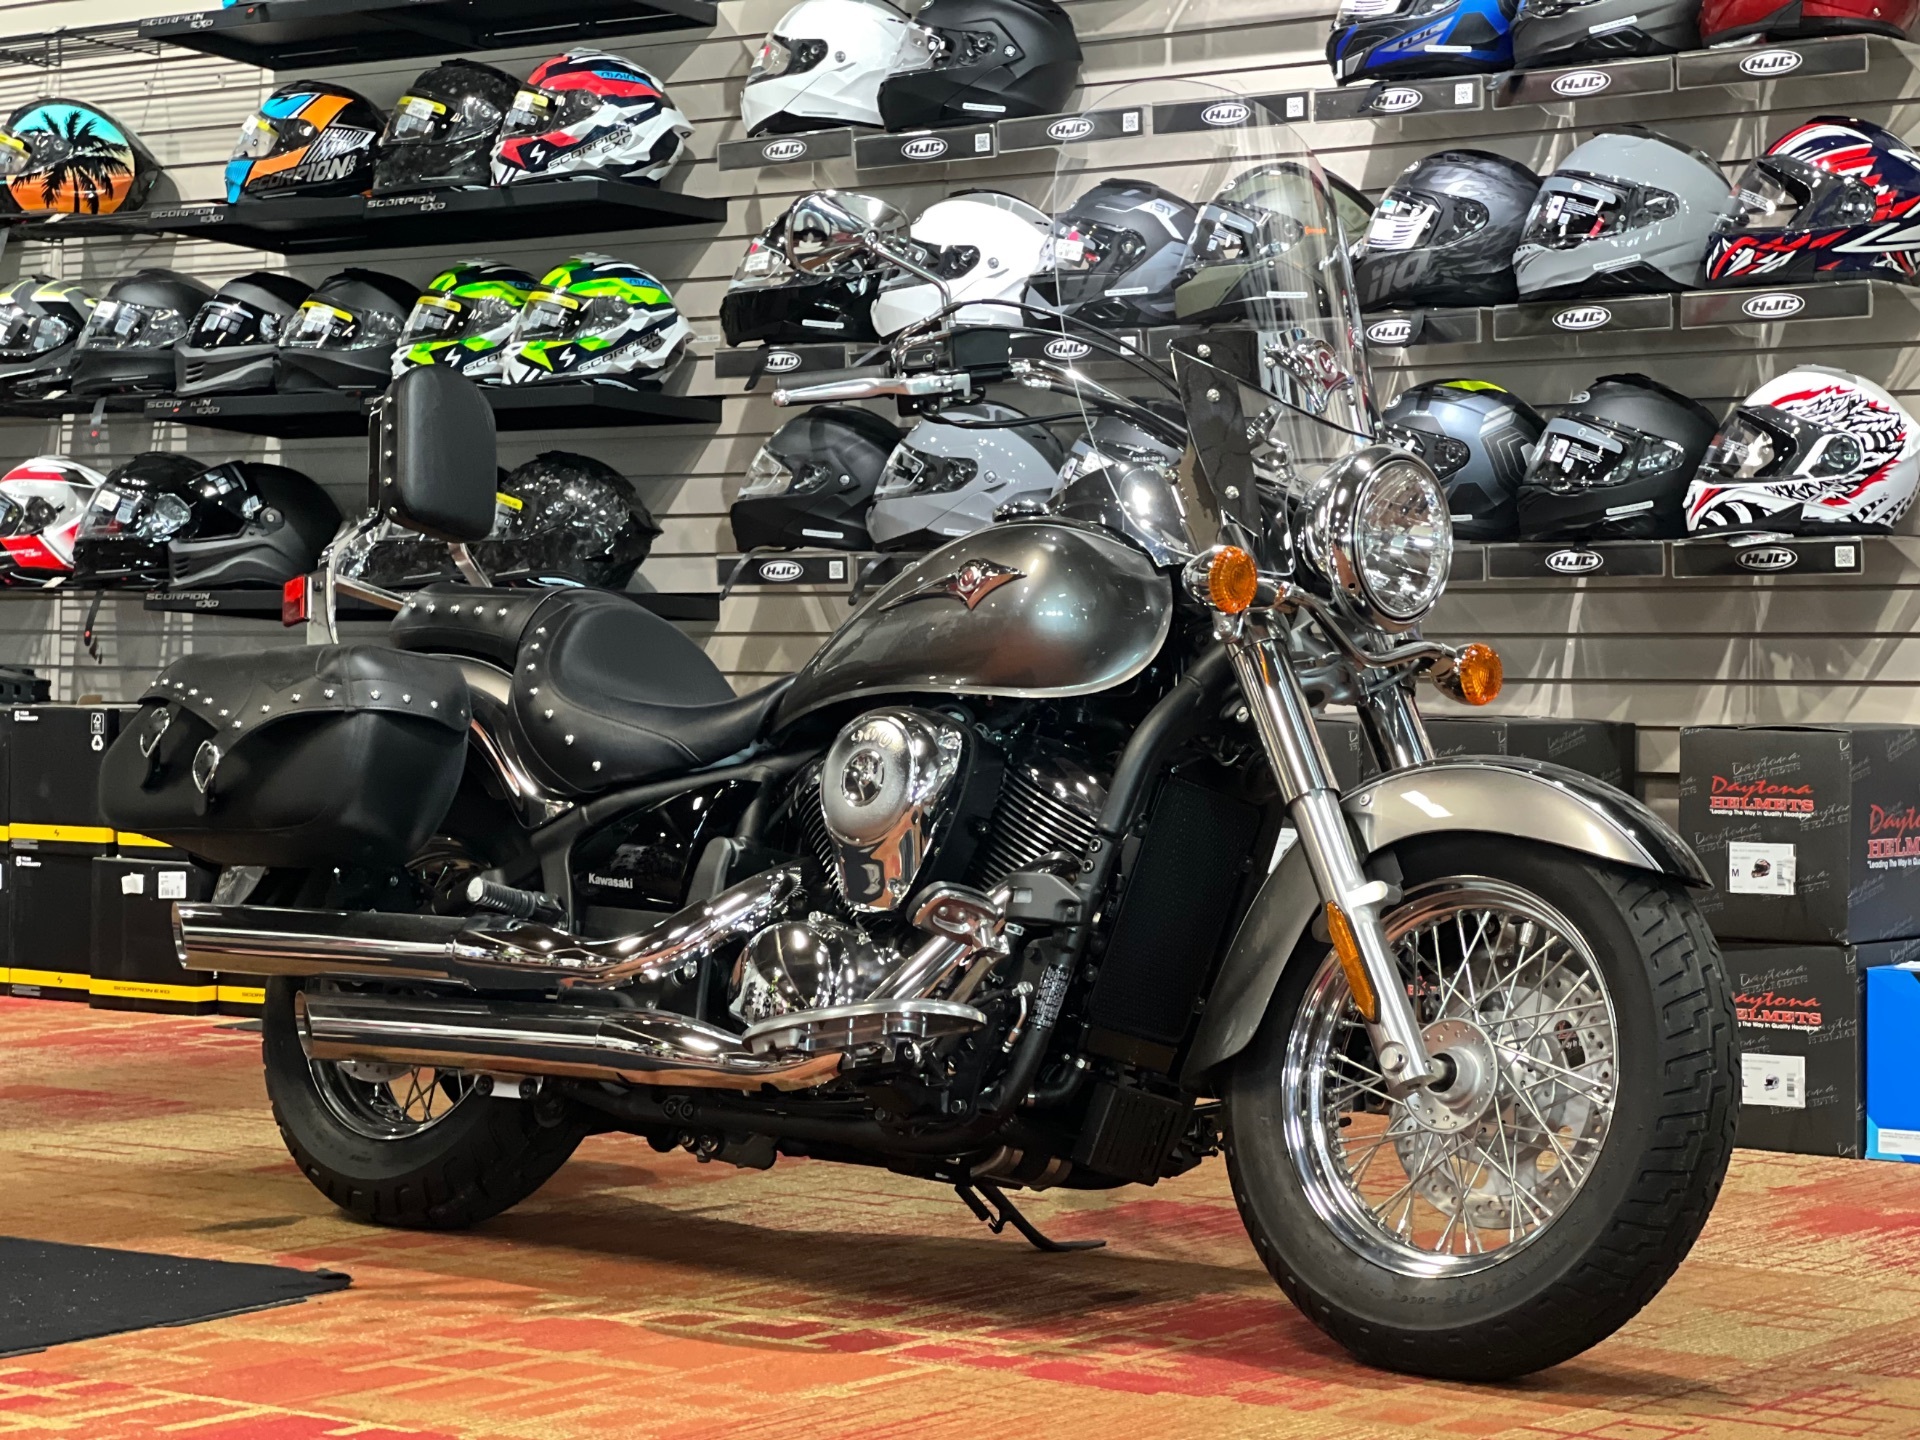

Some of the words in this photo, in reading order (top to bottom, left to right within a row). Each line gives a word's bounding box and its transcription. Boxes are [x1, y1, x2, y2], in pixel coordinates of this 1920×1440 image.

[141, 13, 205, 27] SCORPION
[190, 19, 214, 29] EXO
[1398, 25, 1440, 49] HJC
[1749, 54, 1794, 69] HJC
[1561, 75, 1602, 90] HJC
[1375, 93, 1414, 107] HJC
[1209, 107, 1243, 120] HJC
[1054, 122, 1087, 135] HJC
[549, 126, 632, 170] SCORPION
[769, 144, 800, 156] HJC
[908, 142, 941, 154] HJC
[248, 155, 354, 191] SCORPION
[366, 195, 437, 208] SCORPION
[420, 202, 446, 211] EXO
[150, 207, 215, 219] SCORPION
[200, 214, 225, 223] EXO
[1752, 299, 1796, 312] HJC
[1560, 311, 1603, 325] HJC
[579, 329, 660, 373] SCORPION
[632, 338, 662, 358] EXO
[1554, 556, 1595, 566] HJC
[1744, 552, 1788, 564] HJC
[766, 566, 797, 576] HJC
[145, 592, 211, 601] SCORPION
[195, 600, 219, 608] EXO
[1711, 775, 1815, 800] Daytona
[1709, 795, 1815, 812] HELMETS
[1763, 810, 1782, 818] Quality
[1731, 868, 1739, 877] M
[588, 872, 633, 889] Kawasaki
[1732, 991, 1822, 1011] aytona
[1736, 1008, 1822, 1025] ELMETS
